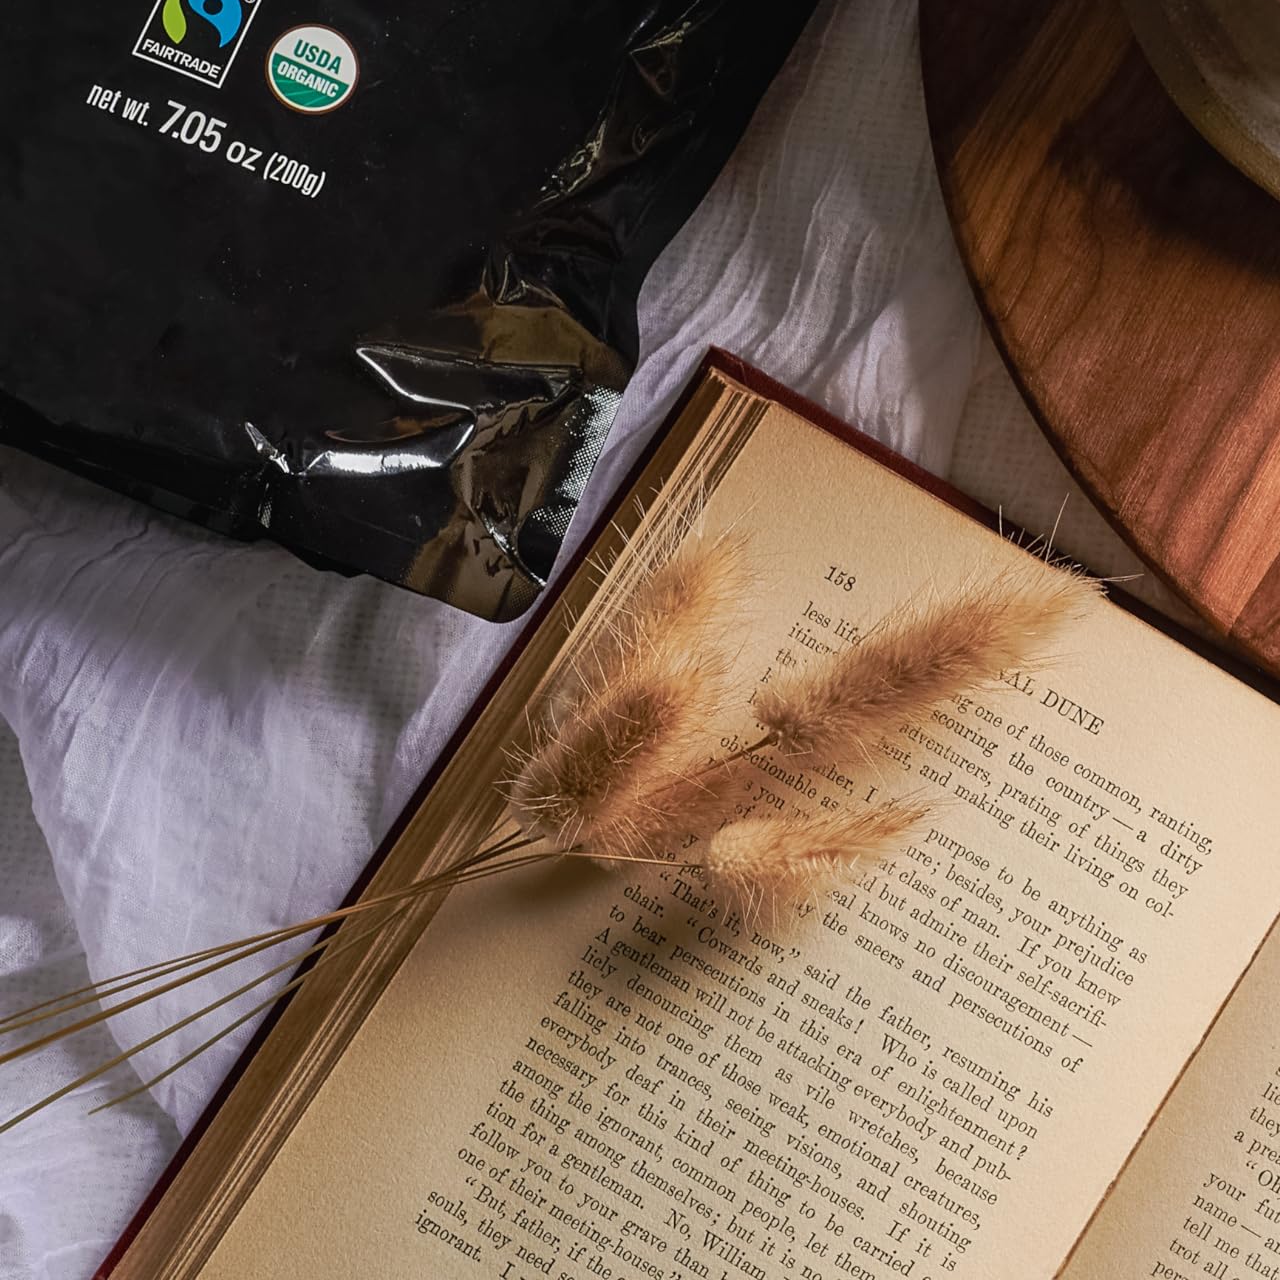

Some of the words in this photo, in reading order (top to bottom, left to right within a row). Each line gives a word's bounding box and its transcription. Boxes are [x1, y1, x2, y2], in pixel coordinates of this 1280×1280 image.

[142, 38, 222, 80] FAIRTRADE
[277, 60, 340, 99] ORGANIC
[293, 39, 343, 75] USDA
[86, 84, 123, 114] net
[122, 97, 150, 127] wt.
[158, 100, 227, 153] 7.05
[226, 140, 263, 172] oz
[263, 152, 327, 198] (200g)
[823, 565, 857, 592] 158
[1038, 687, 1105, 736] DUNE
[918, 764, 953, 788] and
[952, 784, 1015, 830] making
[1018, 819, 1061, 852] their
[1063, 843, 1115, 888] living
[1118, 881, 1139, 901] on
[1144, 897, 1174, 918] col-
[973, 705, 1003, 728] one
[1005, 724, 1029, 741] of
[1028, 733, 1070, 767] those
[1072, 763, 1142, 815] common,
[1147, 806, 1213, 856] ranting,
[996, 781, 1062, 828] prating
[1067, 822, 1091, 839] of
[1093, 833, 1145, 873] things
[1151, 867, 1189, 900] they
[877, 882, 907, 912] but
[908, 907, 967, 947] admire
[971, 940, 1014, 974] their
[1015, 970, 1107, 1028] self-sacrifi-
[897, 869, 937, 900] class
[939, 895, 963, 913] of
[960, 907, 1000, 939] man.
[1015, 935, 1042, 960] If
[1036, 954, 1073, 980] you
[1074, 969, 1121, 1007] knew
[922, 827, 990, 872] purpose
[996, 866, 1014, 885] to
[1020, 876, 1041, 902] be
[1047, 899, 1124, 953] anything
[1127, 947, 1148, 964] as
[802, 964, 841, 991] said
[844, 985, 871, 1011] the
[876, 1005, 931, 1052] father,
[941, 1045, 1021, 1102] resuming
[1026, 1090, 1054, 1118] his
[821, 911, 848, 936] the
[853, 934, 905, 970] sneers
[911, 968, 947, 993] and
[947, 991, 1053, 1058] persecutions
[1060, 1056, 1084, 1074] of
[552, 990, 608, 1036] falling
[612, 1025, 646, 1056] into
[655, 1053, 712, 1102] trances,
[723, 1098, 776, 1138] seeing
[786, 1133, 842, 1180] visions,
[855, 1177, 892, 1203] and
[897, 1200, 972, 1254] shouting
[579, 944, 618, 980] licly
[625, 973, 714, 1040] denouncing
[723, 1033, 763, 1067] them
[774, 1067, 793, 1084] as
[805, 1083, 835, 1110] vile
[848, 1109, 919, 1165] wretches,
[934, 1156, 998, 1206] because
[426, 1191, 468, 1227] souls,
[476, 1217, 512, 1251] they
[514, 1244, 556, 1276] need
[468, 1121, 521, 1160] follow
[519, 1157, 553, 1183] you
[557, 1173, 574, 1195] to
[575, 1192, 619, 1222] your
[619, 1219, 667, 1253] grave
[672, 1246, 710, 1280] than
[485, 1100, 517, 1131] tion
[518, 1121, 547, 1147] for
[548, 1143, 560, 1158] a
[559, 1152, 644, 1210] gentleman.
[662, 1207, 691, 1242] No,
[1168, 1237, 1201, 1265] trot
[1202, 1260, 1229, 1280] all
[1182, 1215, 1213, 1242] tell
[1212, 1237, 1240, 1259] me
[1244, 1252, 1280, 1280] that
